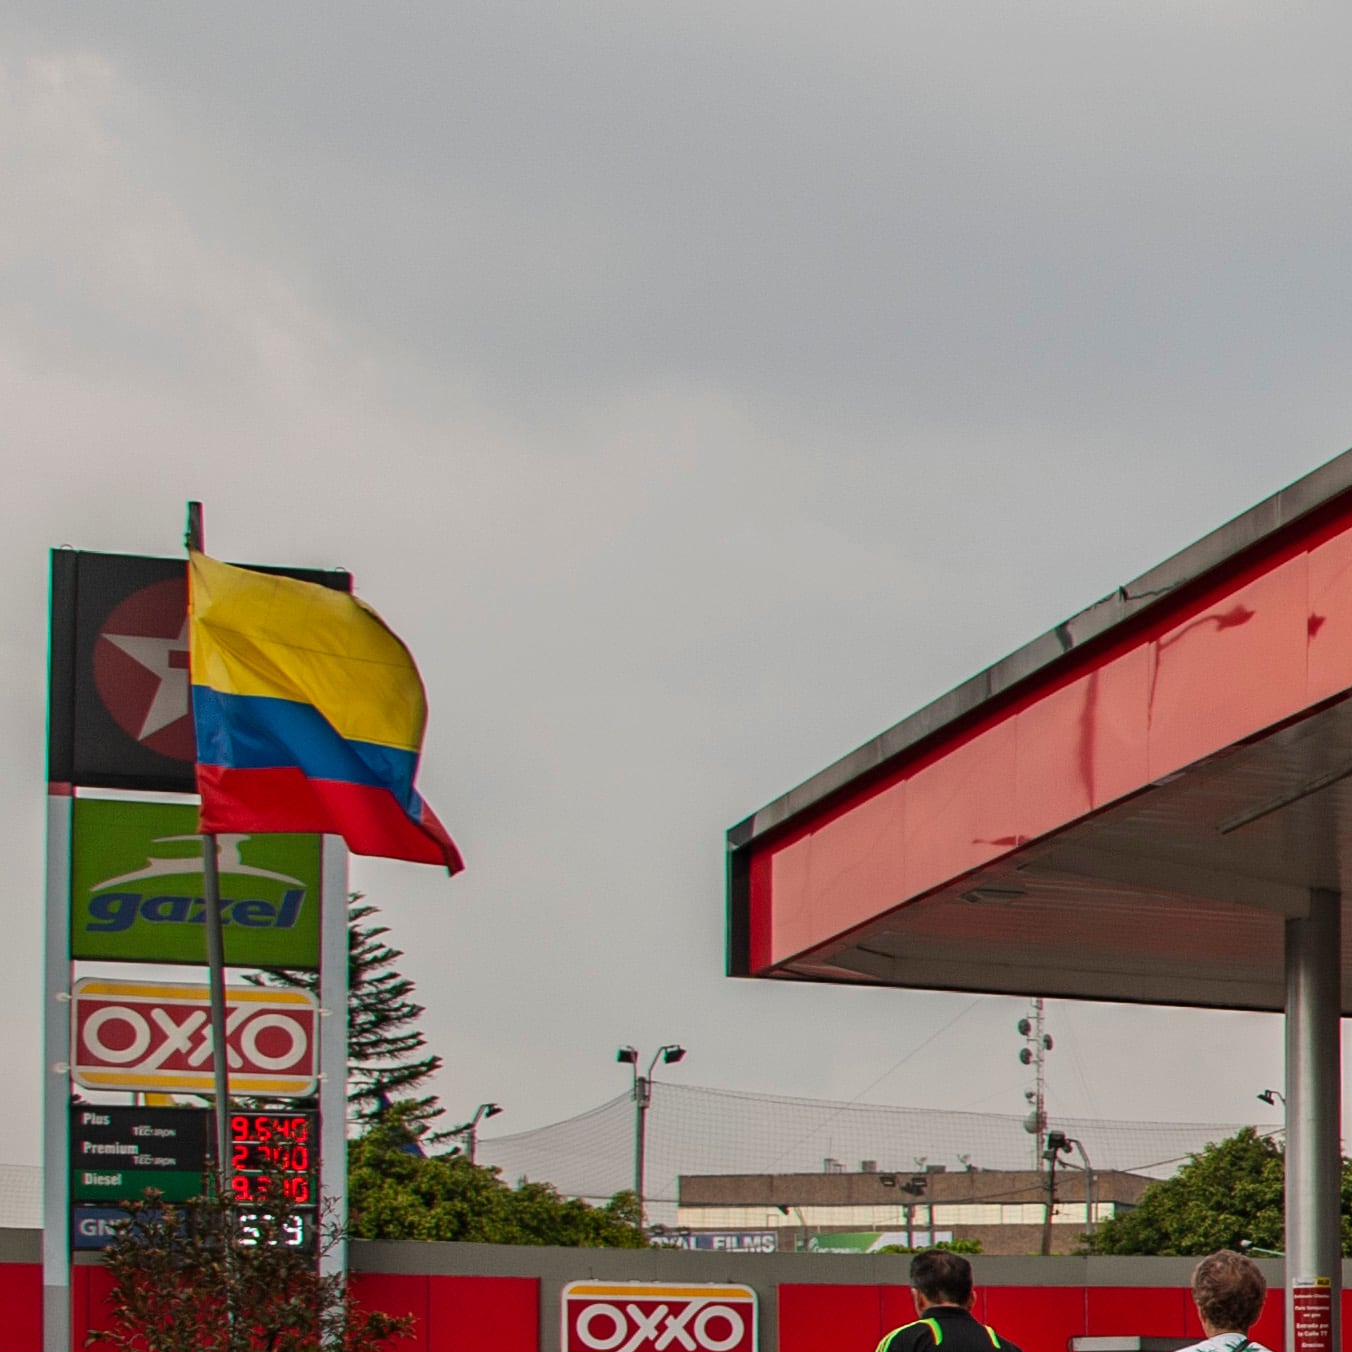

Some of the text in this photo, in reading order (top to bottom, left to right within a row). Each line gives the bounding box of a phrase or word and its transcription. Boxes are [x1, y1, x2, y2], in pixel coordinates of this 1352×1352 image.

[85, 889, 306, 932] gazel
[82, 1004, 307, 1071] OXXO
[82, 1112, 111, 1126] Plus
[83, 1142, 139, 1155] Premium
[82, 1173, 123, 1186] Diesel
[713, 1235, 776, 1253] FILMS
[576, 1302, 745, 1352] OXXO
